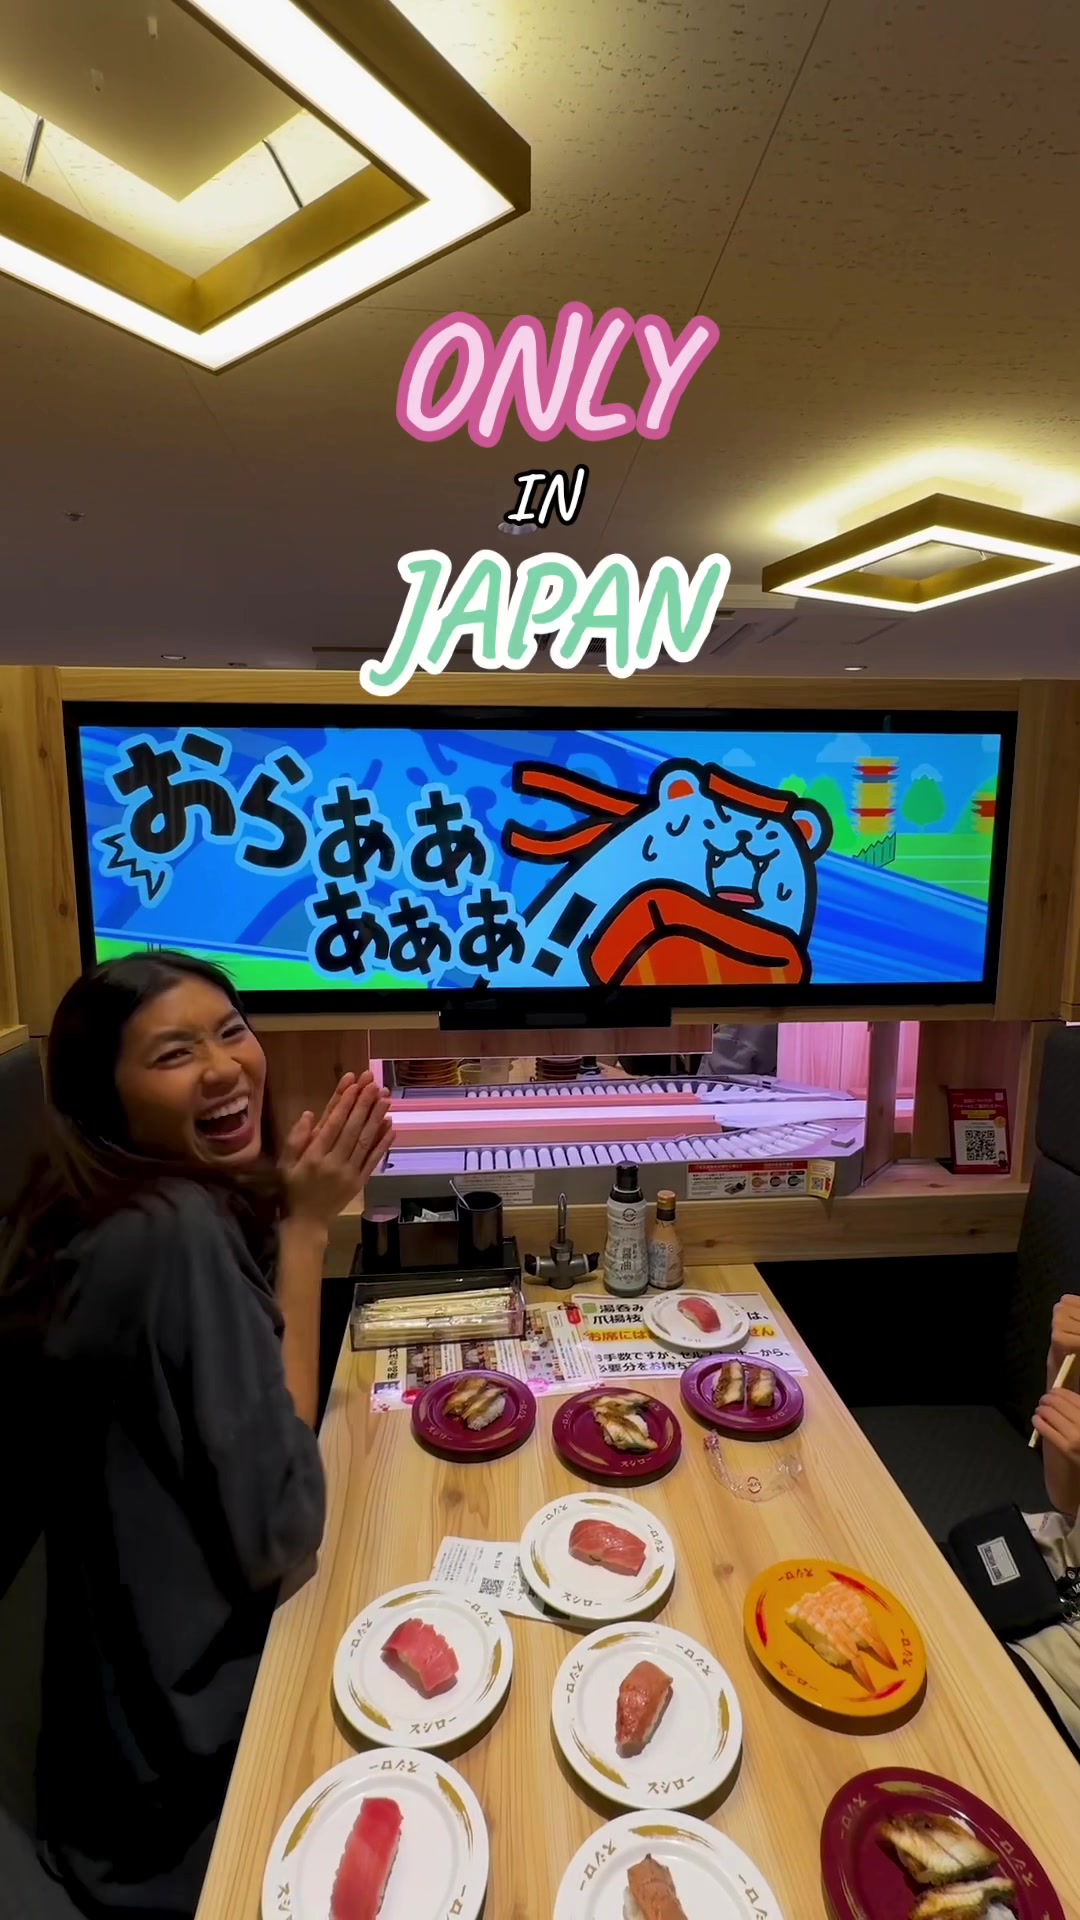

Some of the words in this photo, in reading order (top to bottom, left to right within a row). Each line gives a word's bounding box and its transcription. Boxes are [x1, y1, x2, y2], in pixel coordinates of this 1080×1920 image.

[562, 1591, 602, 1607] スシロー
[676, 1643, 713, 1677] スシロー
[566, 1660, 585, 1704] スシロー
[409, 1716, 457, 1734] スシロー
[369, 1759, 420, 1773] スシロー
[648, 1776, 695, 1794] スシロー
[579, 1838, 616, 1891] スシロー
